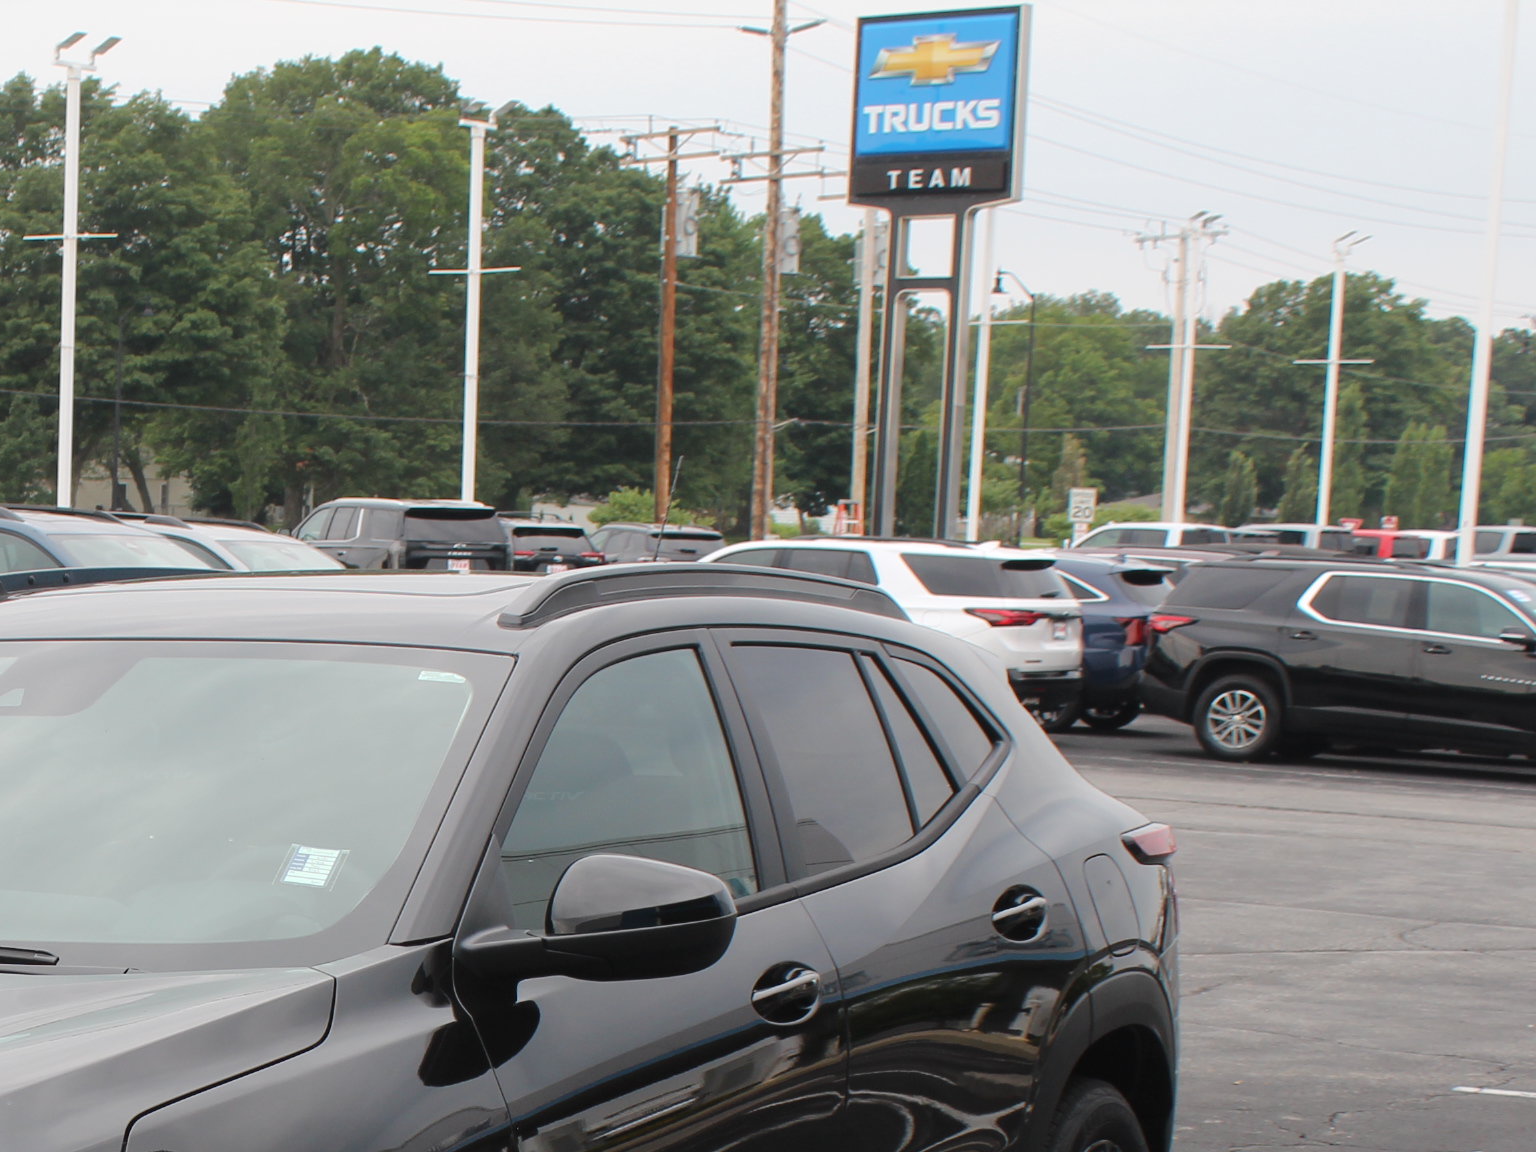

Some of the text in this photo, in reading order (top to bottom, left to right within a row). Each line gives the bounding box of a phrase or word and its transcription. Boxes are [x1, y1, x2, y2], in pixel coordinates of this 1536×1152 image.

[863, 98, 1001, 134] TRUCKS
[887, 166, 972, 190] TEAM
[1072, 505, 1092, 518] 20
